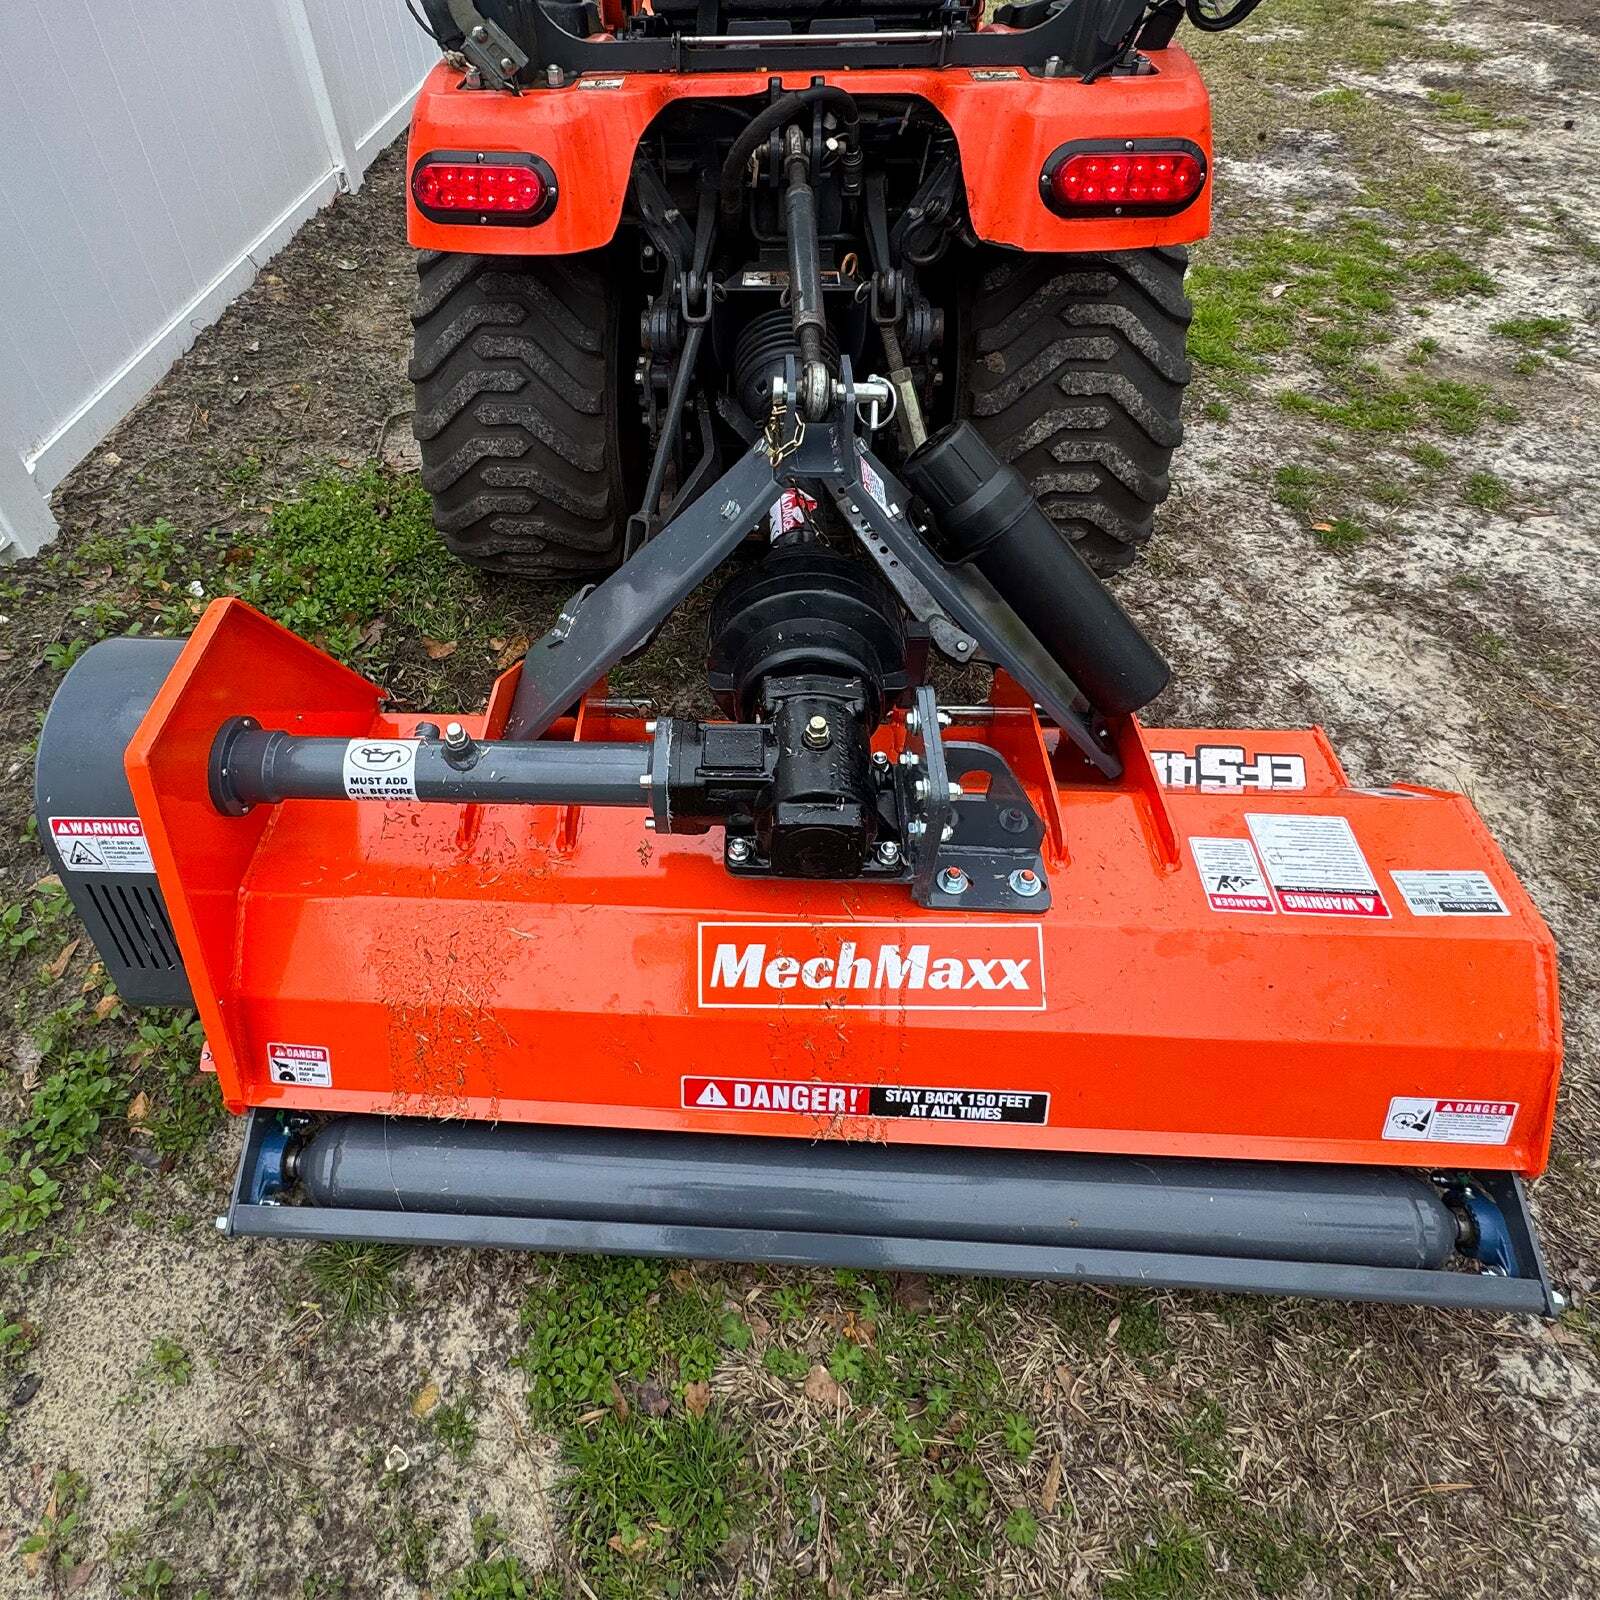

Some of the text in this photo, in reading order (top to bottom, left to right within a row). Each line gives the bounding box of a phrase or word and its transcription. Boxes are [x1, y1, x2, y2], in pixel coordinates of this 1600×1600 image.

[350, 777, 408, 785] MUST ADD
[348, 787, 367, 795] OIL
[70, 822, 141, 834] WARNING
[1213, 897, 1258, 908] DANGER
[1284, 895, 1359, 911] WARNING
[710, 942, 1031, 990] MechMaxx
[286, 1048, 324, 1060] DANGER
[734, 1083, 1033, 1113] DANGER! STAY BACK 150 FEET
[910, 1104, 1002, 1120] AT ALL TIMES
[1455, 1102, 1508, 1114] DANGER
